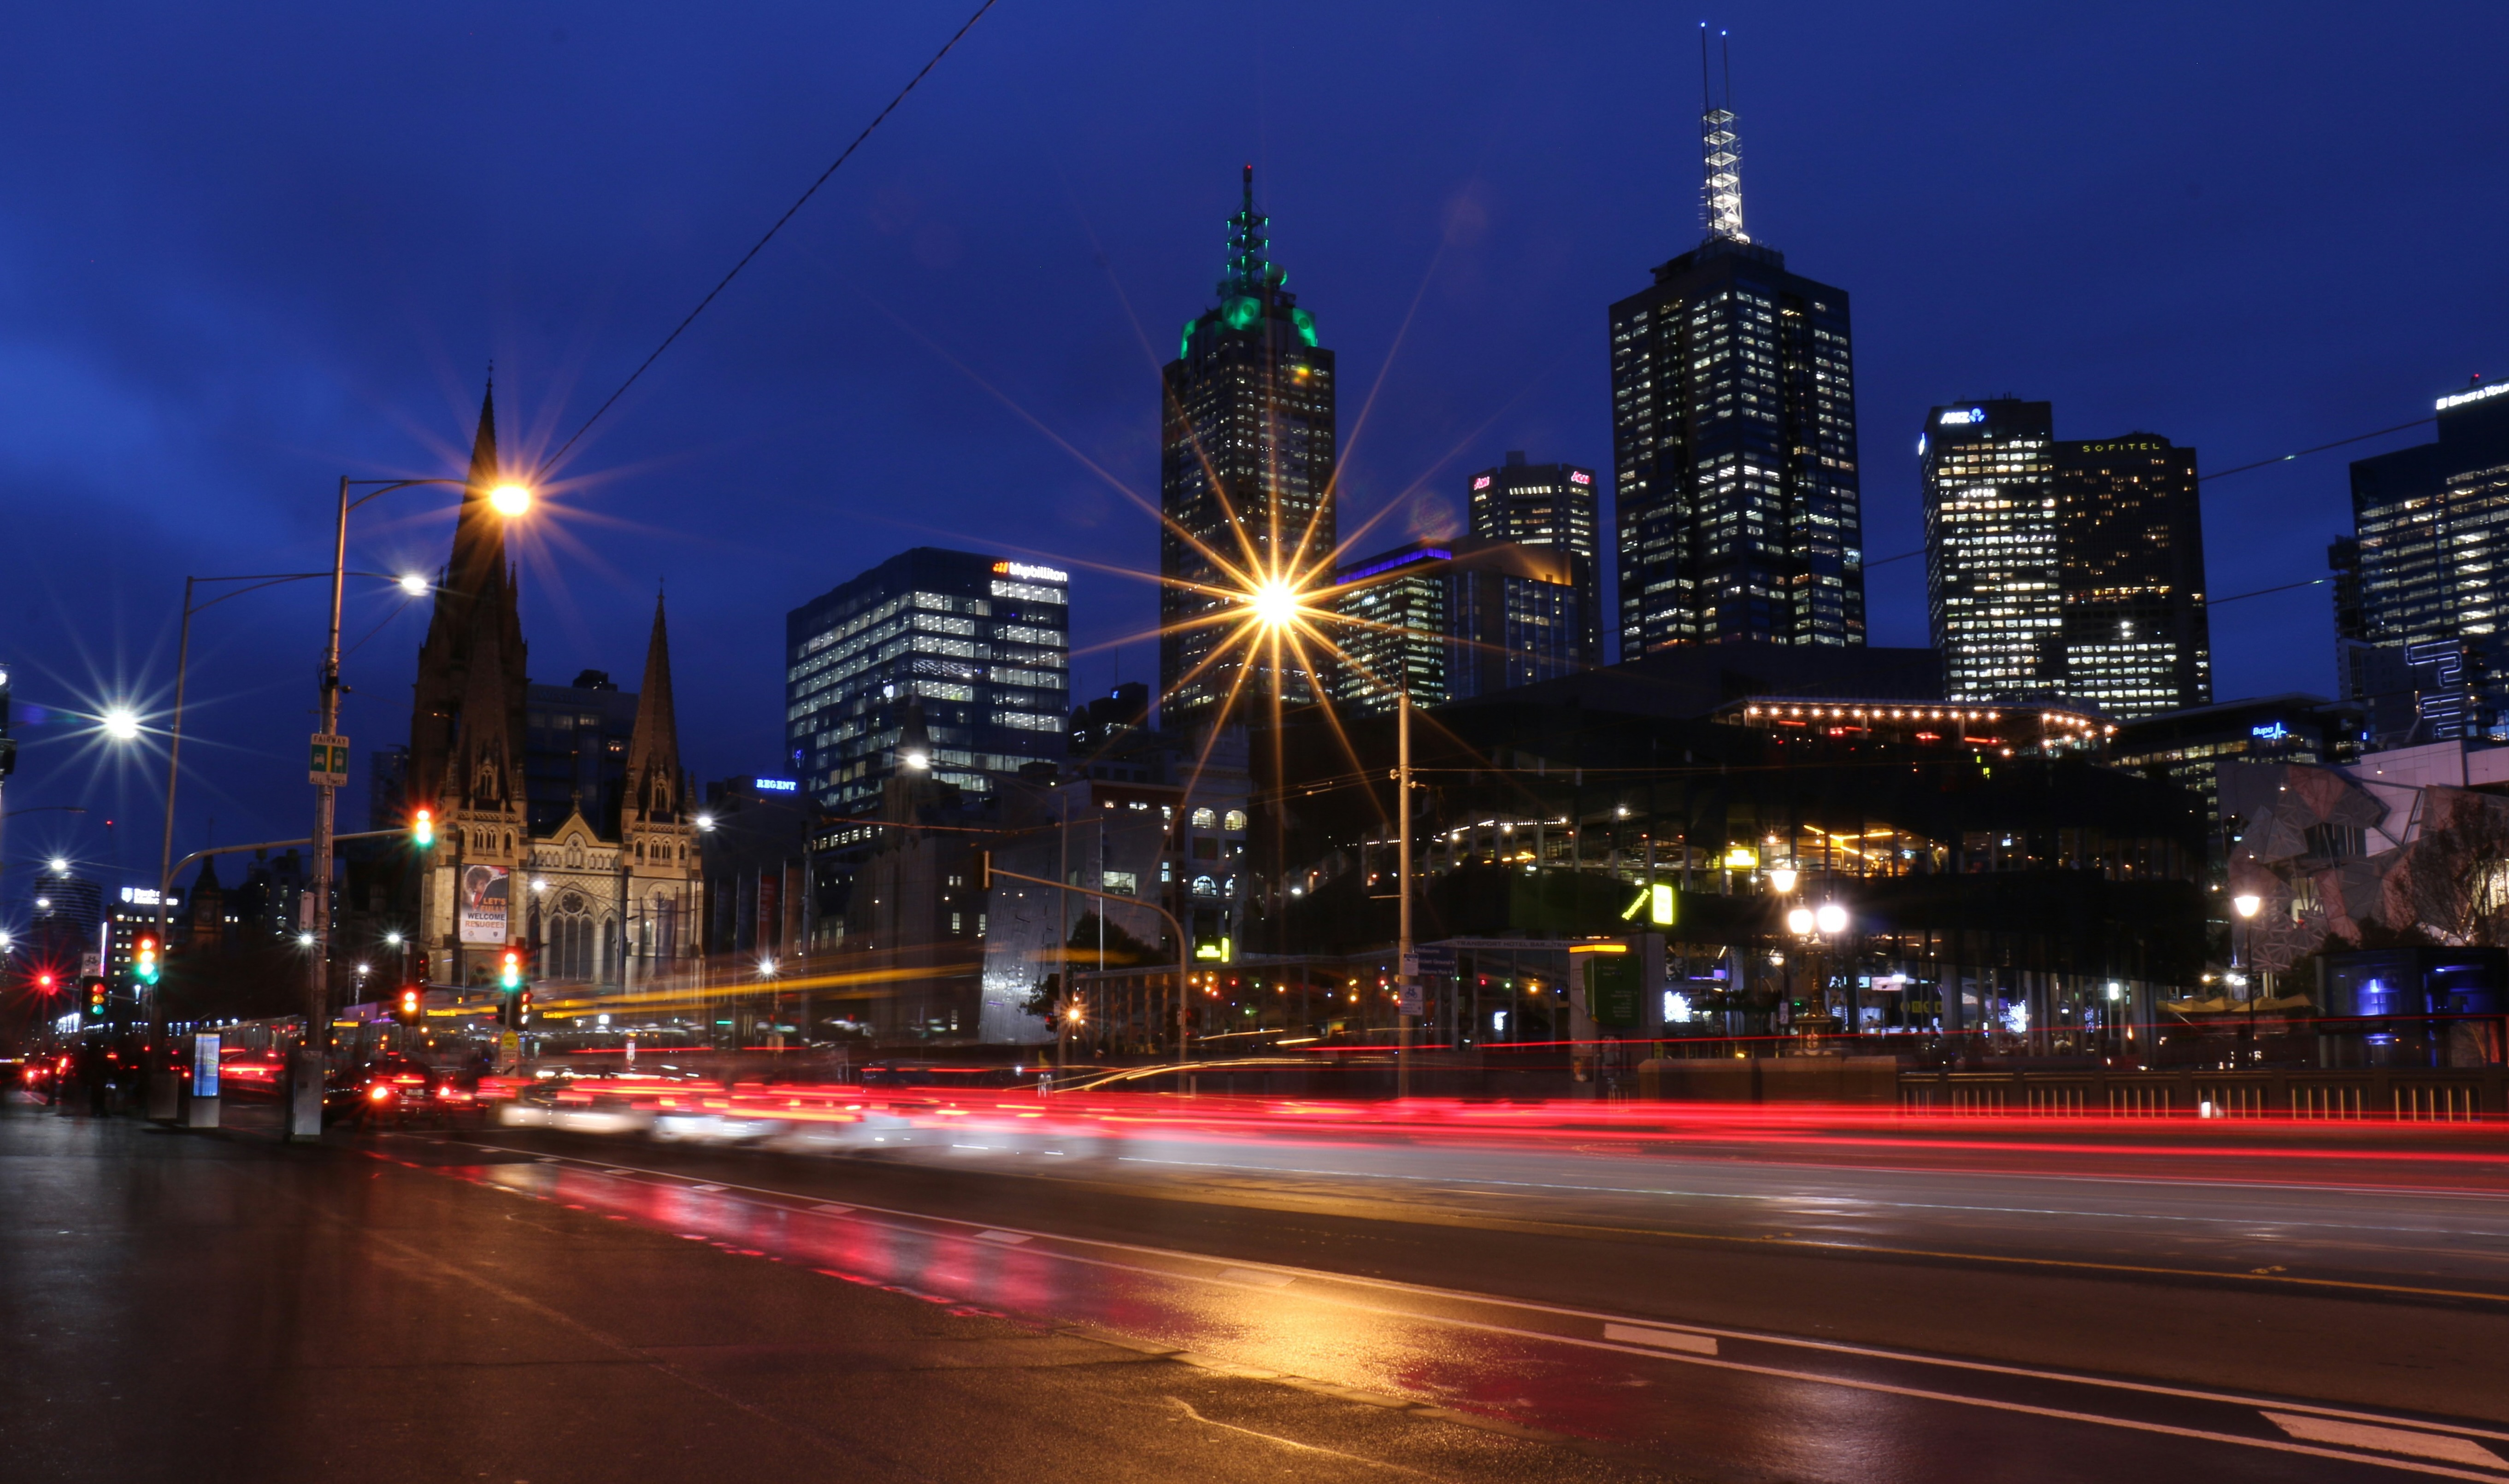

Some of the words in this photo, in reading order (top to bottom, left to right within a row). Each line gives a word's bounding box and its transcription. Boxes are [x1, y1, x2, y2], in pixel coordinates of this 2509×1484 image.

[1941, 412, 1970, 424] ANZ
[2082, 443, 2160, 452] SOFITEL
[1009, 562, 1068, 582] bhpbilliton
[2253, 727, 2274, 736] Bupa
[314, 735, 347, 745] FAIRWAY
[756, 779, 796, 790] REGENT
[483, 897, 506, 905] LET'S
[467, 912, 506, 921] WELCOME
[465, 920, 505, 929] REFUGEES
